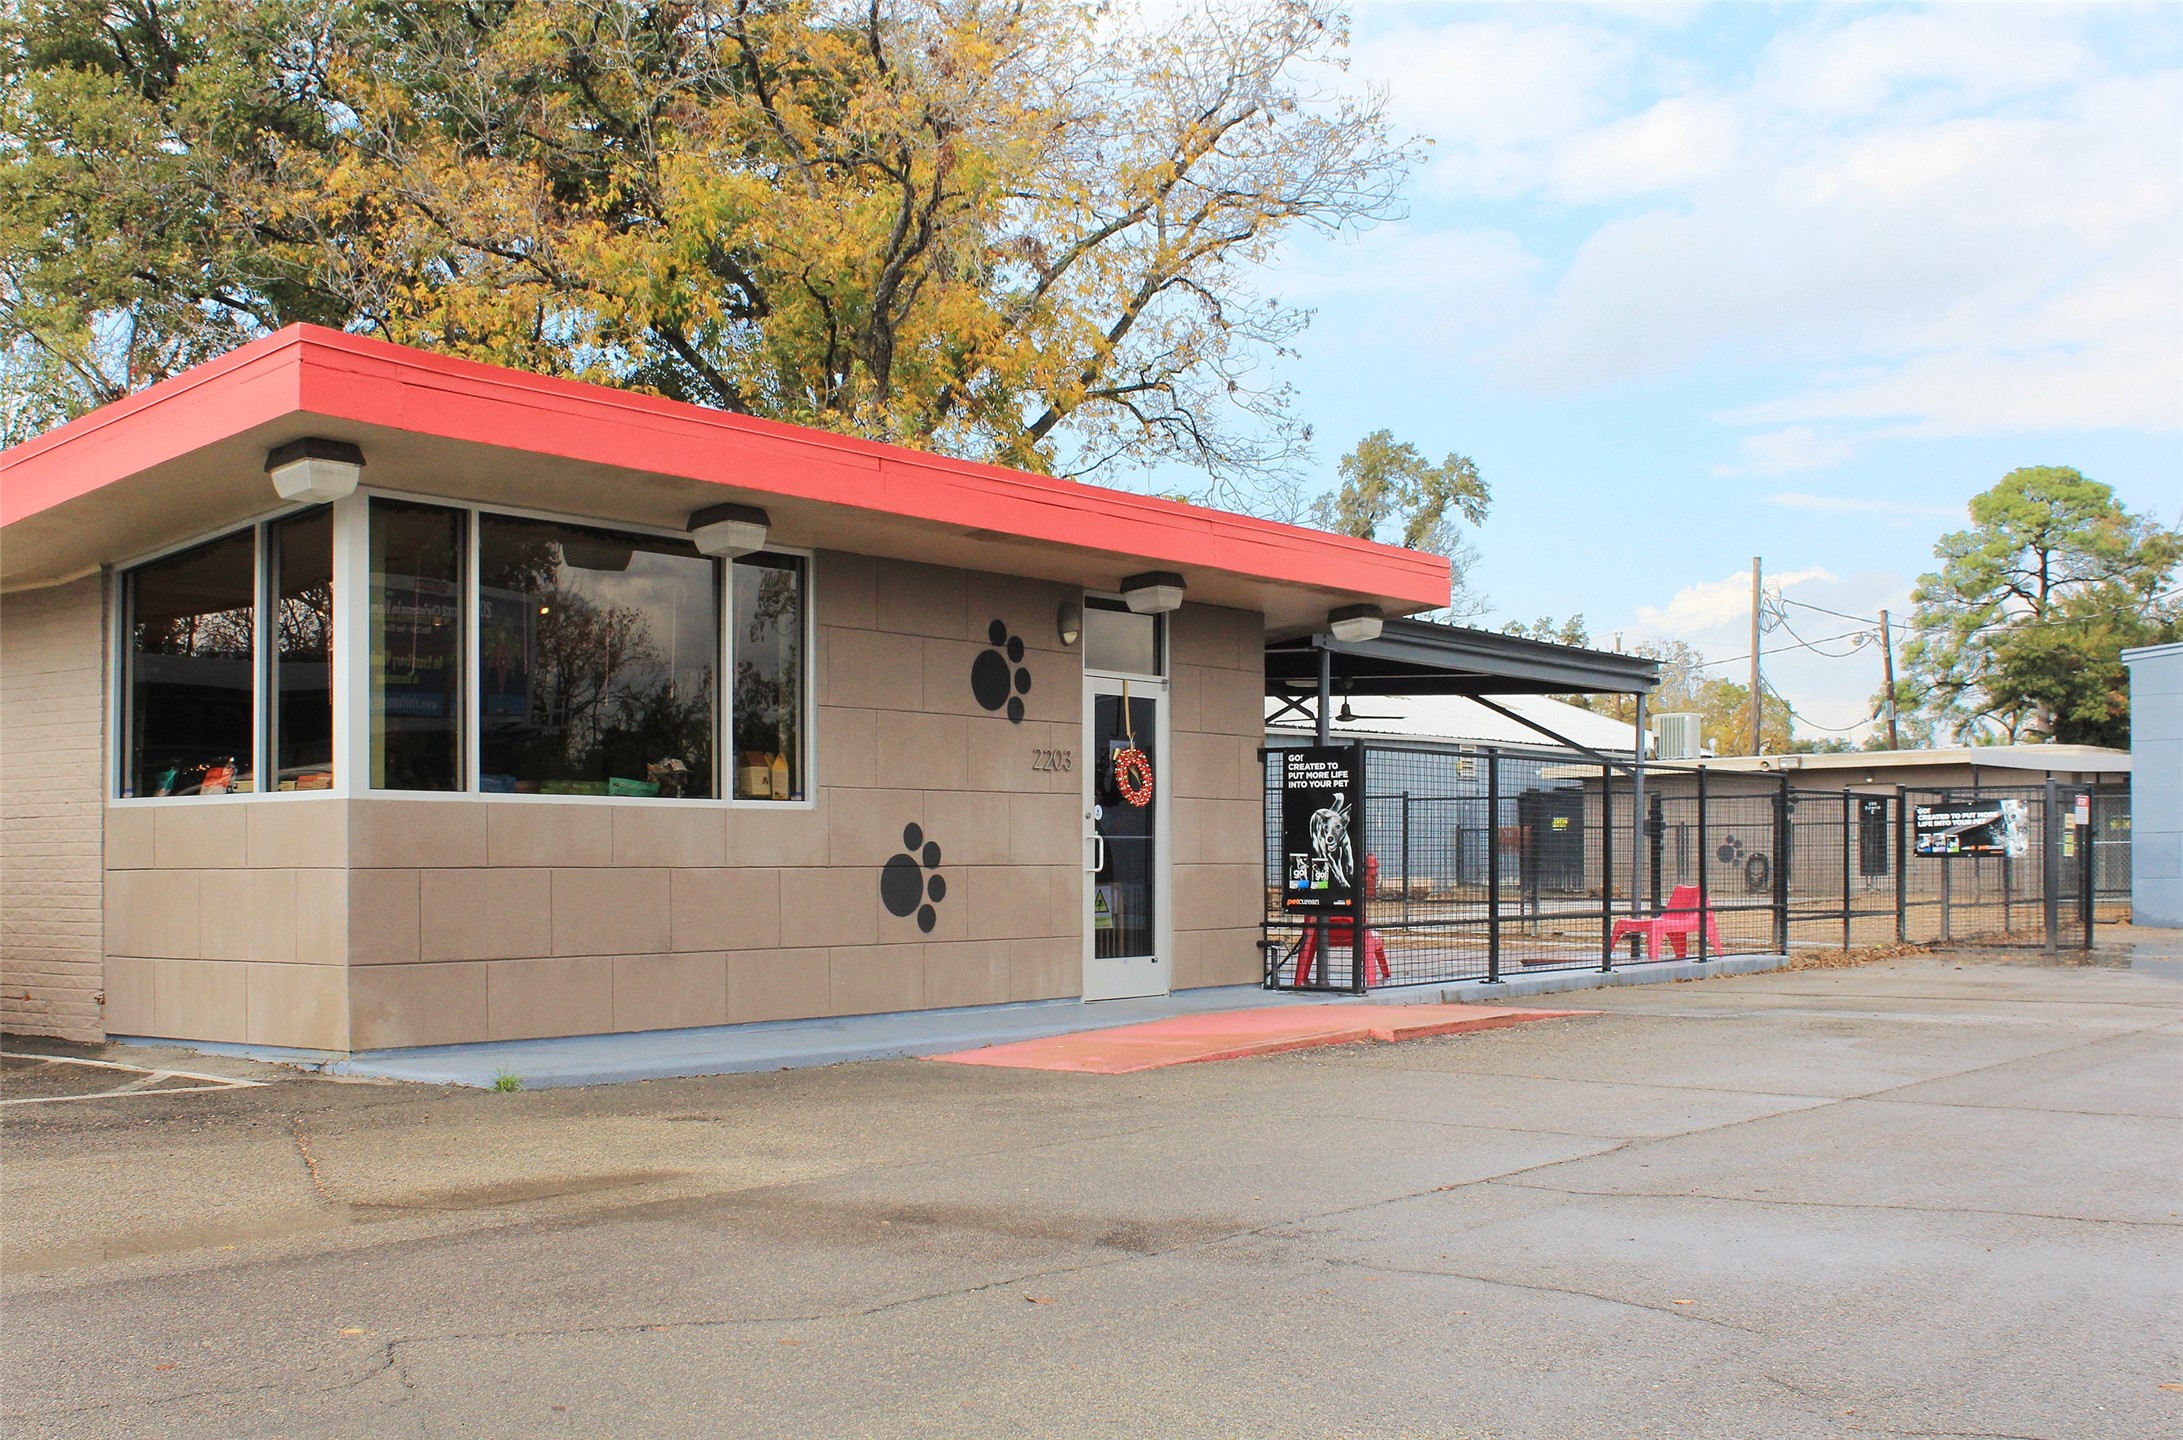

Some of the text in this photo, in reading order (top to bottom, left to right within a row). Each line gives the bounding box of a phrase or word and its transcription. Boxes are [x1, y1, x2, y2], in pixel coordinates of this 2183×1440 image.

[1032, 747, 1072, 770] 2203
[1288, 754, 1304, 762] GO!
[1288, 762, 1338, 771] CREATED TO
[1288, 770, 1349, 779] PUT MORE LIFE
[1288, 779, 1349, 789] INTO YOUR PET
[1917, 813, 1950, 821] CREATED
[1917, 820, 1933, 828] LIFE
[1934, 819, 1951, 827] INTO
